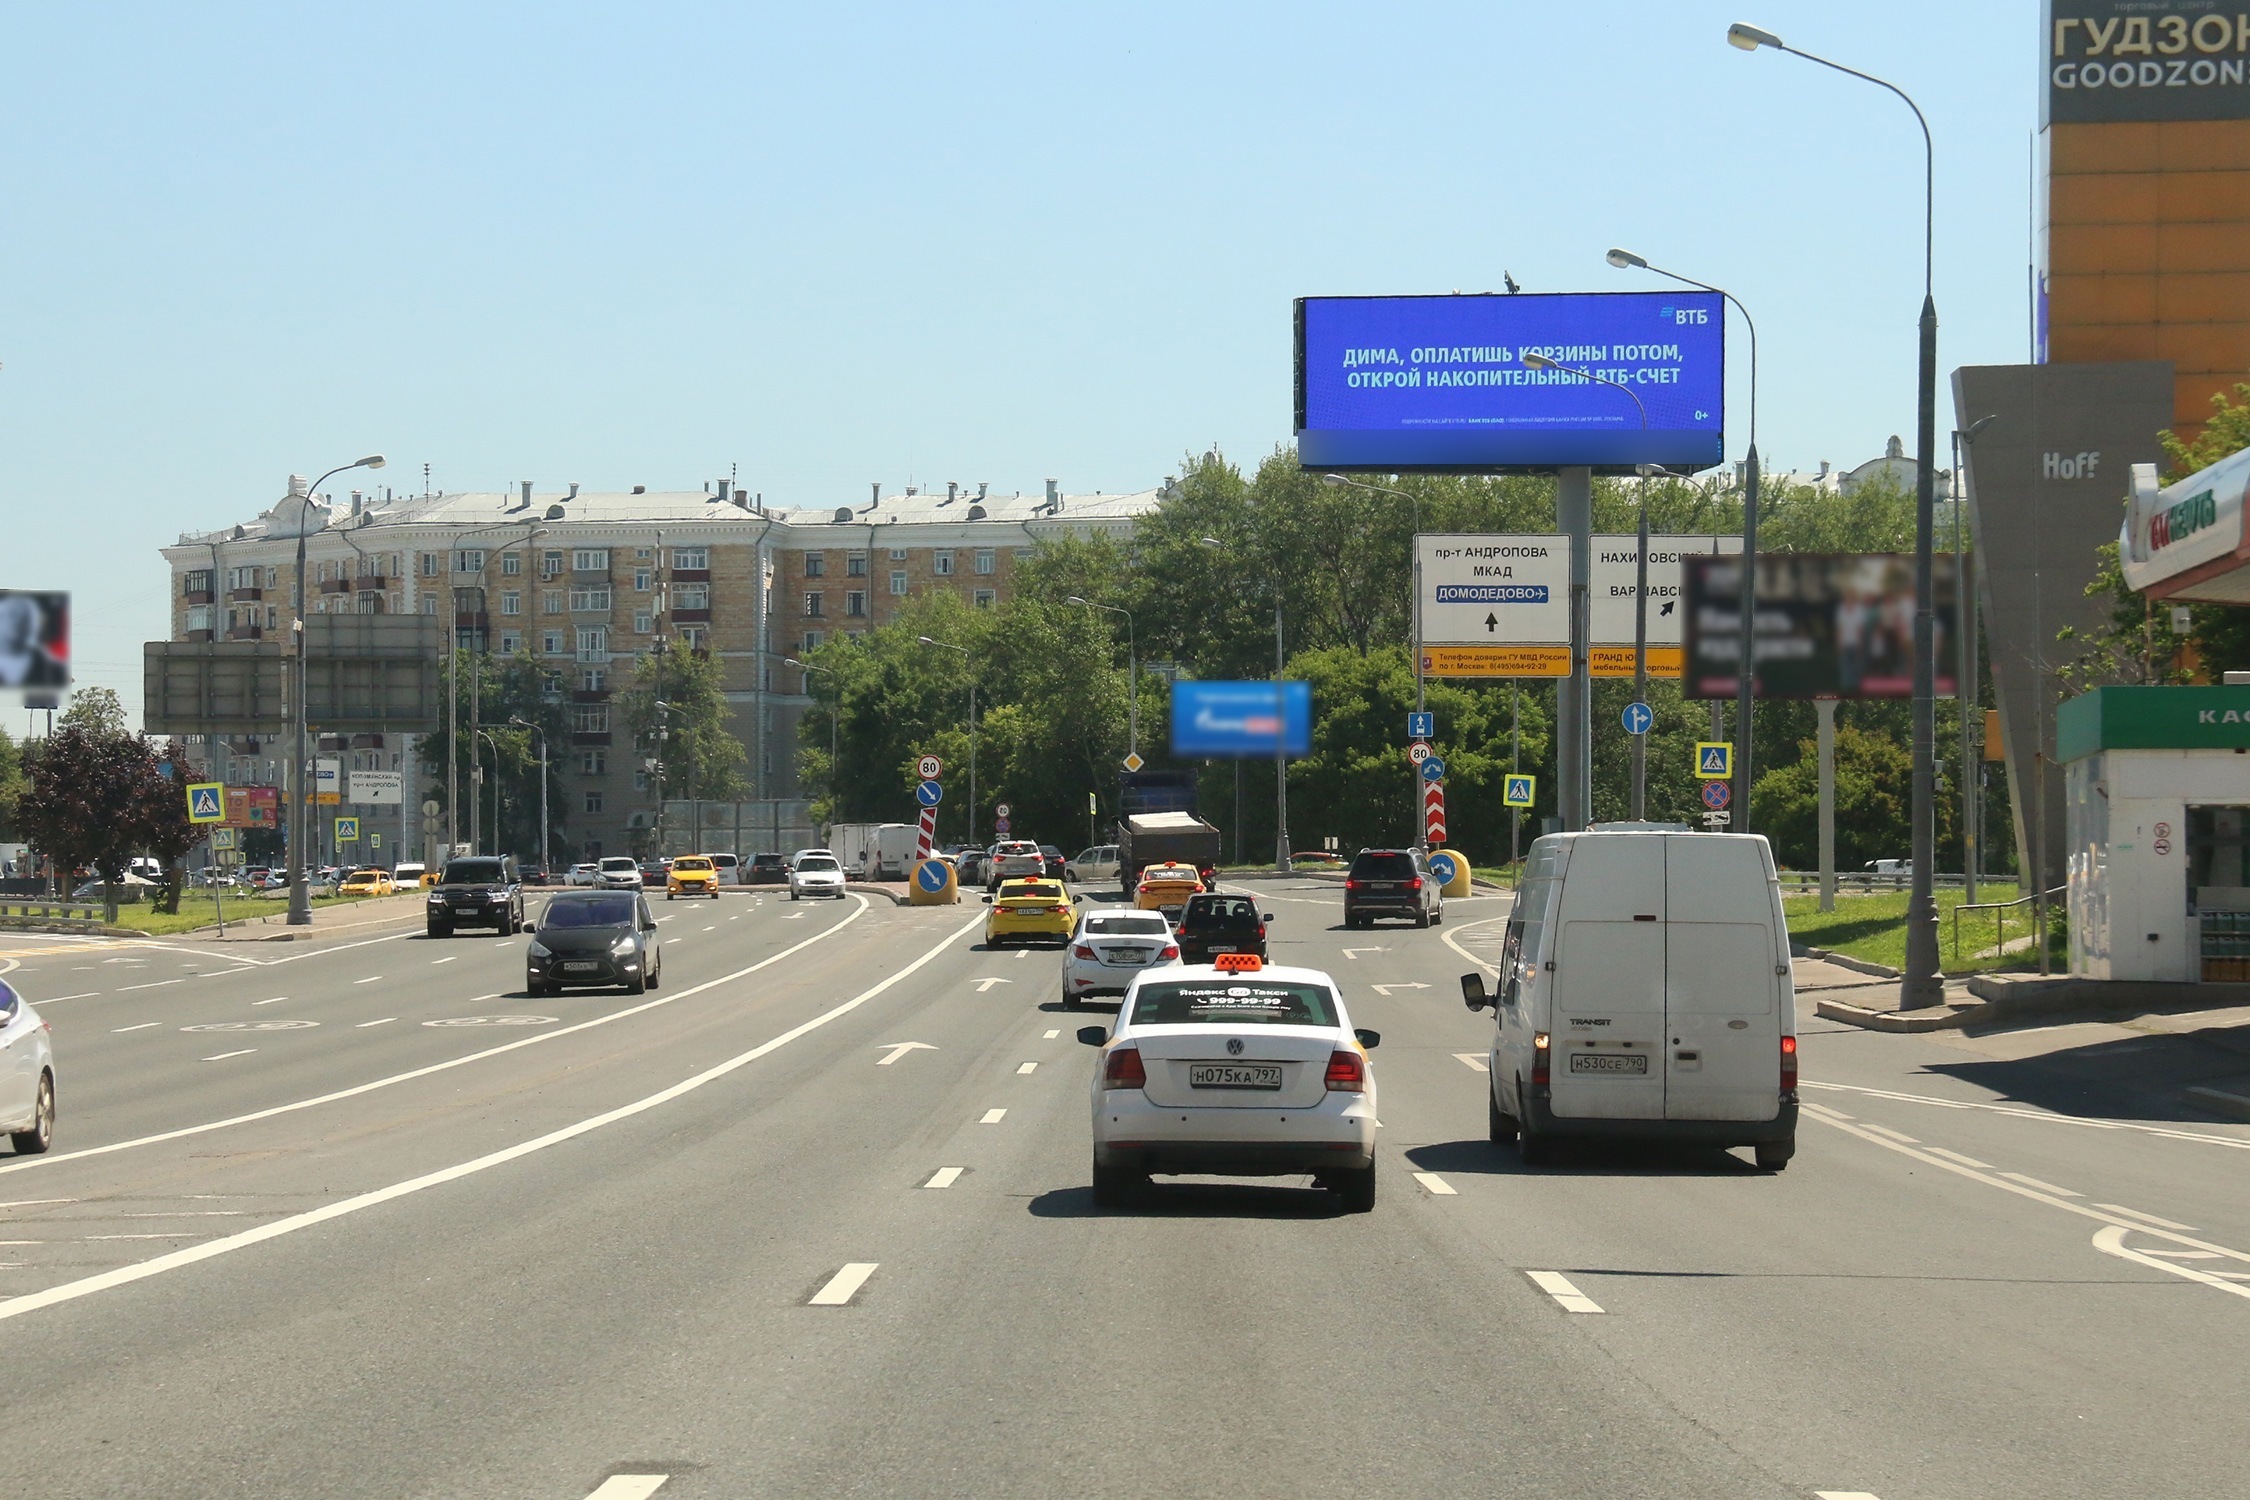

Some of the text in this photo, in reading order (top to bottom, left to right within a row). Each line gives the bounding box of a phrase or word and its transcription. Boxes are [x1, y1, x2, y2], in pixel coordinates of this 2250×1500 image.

[2052, 60, 2250, 88] GOODZON
[1676, 310, 1708, 324] ВТБ
[1343, 348, 1404, 368] ДИМА,
[1410, 347, 1512, 364] ОПЛАТИШЬ
[1613, 344, 1684, 362] ПОТОМ,
[1348, 366, 1680, 388] ОТКРОЙ НАКОПИТЕЛЬНЫЙ ВТБ-СЧЕТ
[1694, 410, 1708, 420] 0+
[2043, 451, 2100, 479] Hoff
[1436, 547, 1548, 560] пр-т АНДРОПОВА
[1474, 566, 1512, 578] МКАД
[1438, 588, 1534, 600] ДОМОДЕДОВО
[1593, 654, 1622, 662] ГРАНД
[1414, 749, 1427, 758] 80
[922, 762, 936, 773] 80
[1252, 988, 1288, 996] Такси
[1209, 997, 1282, 1005] 999-99-99
[1576, 1057, 1642, 1070] Н530СЕ 790
[1196, 1068, 1276, 1083] Н075КА 797
